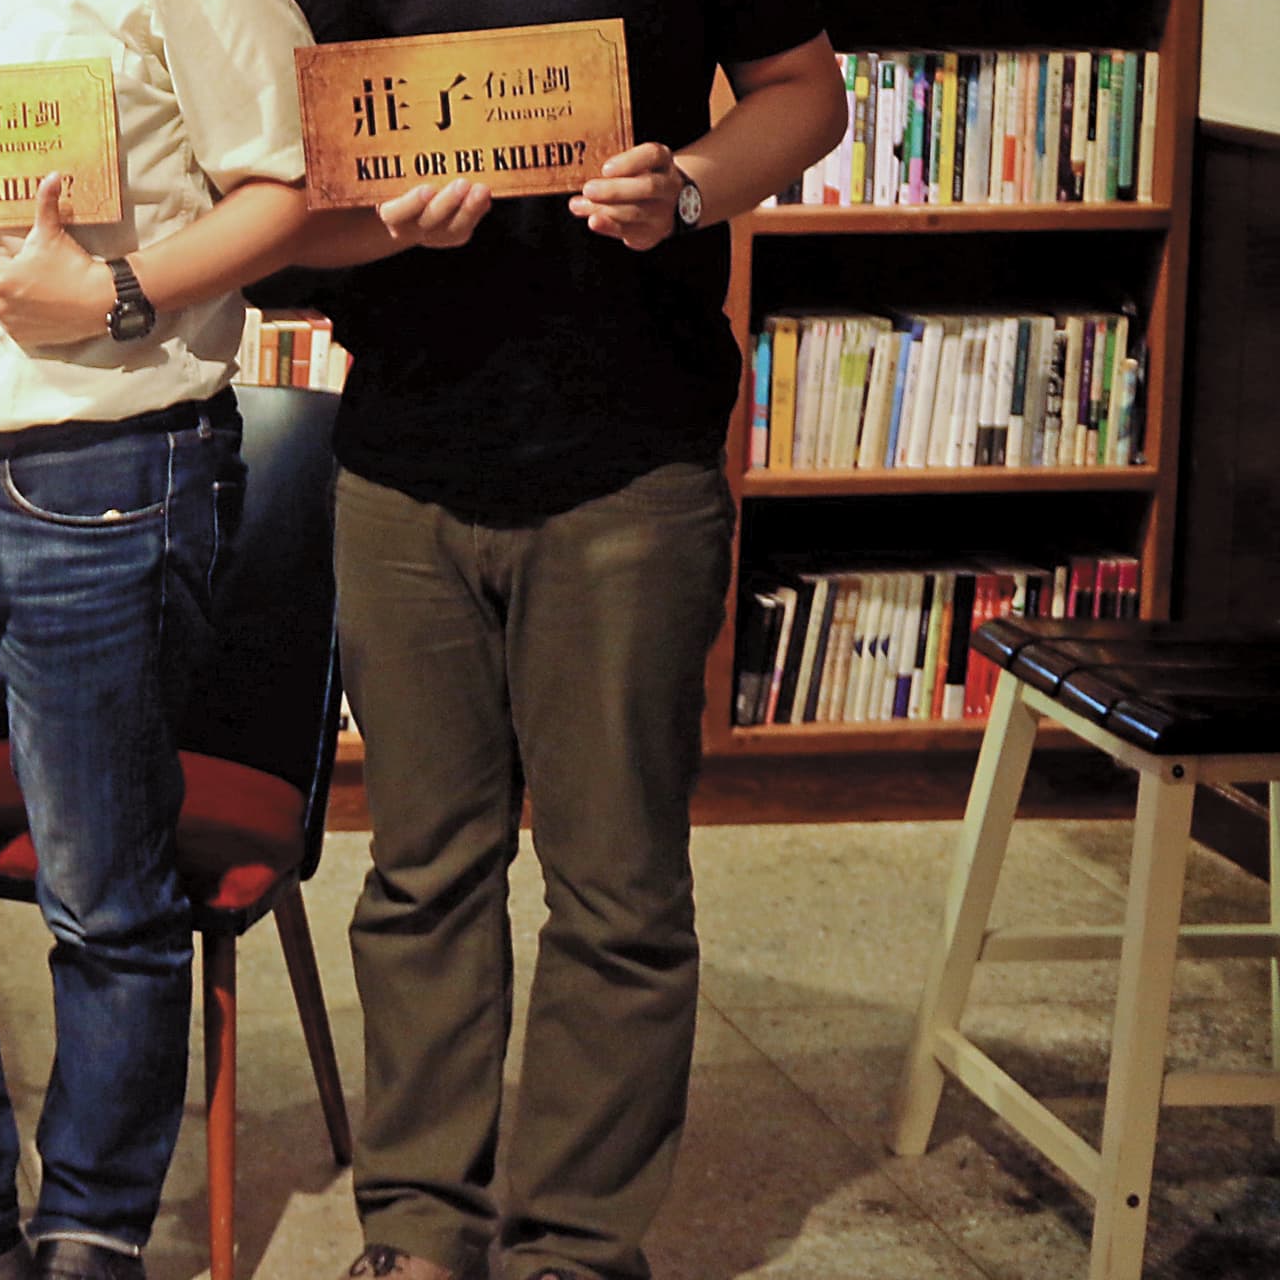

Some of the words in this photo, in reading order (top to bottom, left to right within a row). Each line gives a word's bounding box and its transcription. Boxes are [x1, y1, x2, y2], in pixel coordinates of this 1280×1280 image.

[353, 73, 472, 136] 莊子
[486, 101, 572, 122] Zhuangzi
[356, 155, 406, 180] KILL
[415, 152, 446, 176] OR
[455, 148, 484, 173] BE
[493, 140, 586, 171] KILLED?
